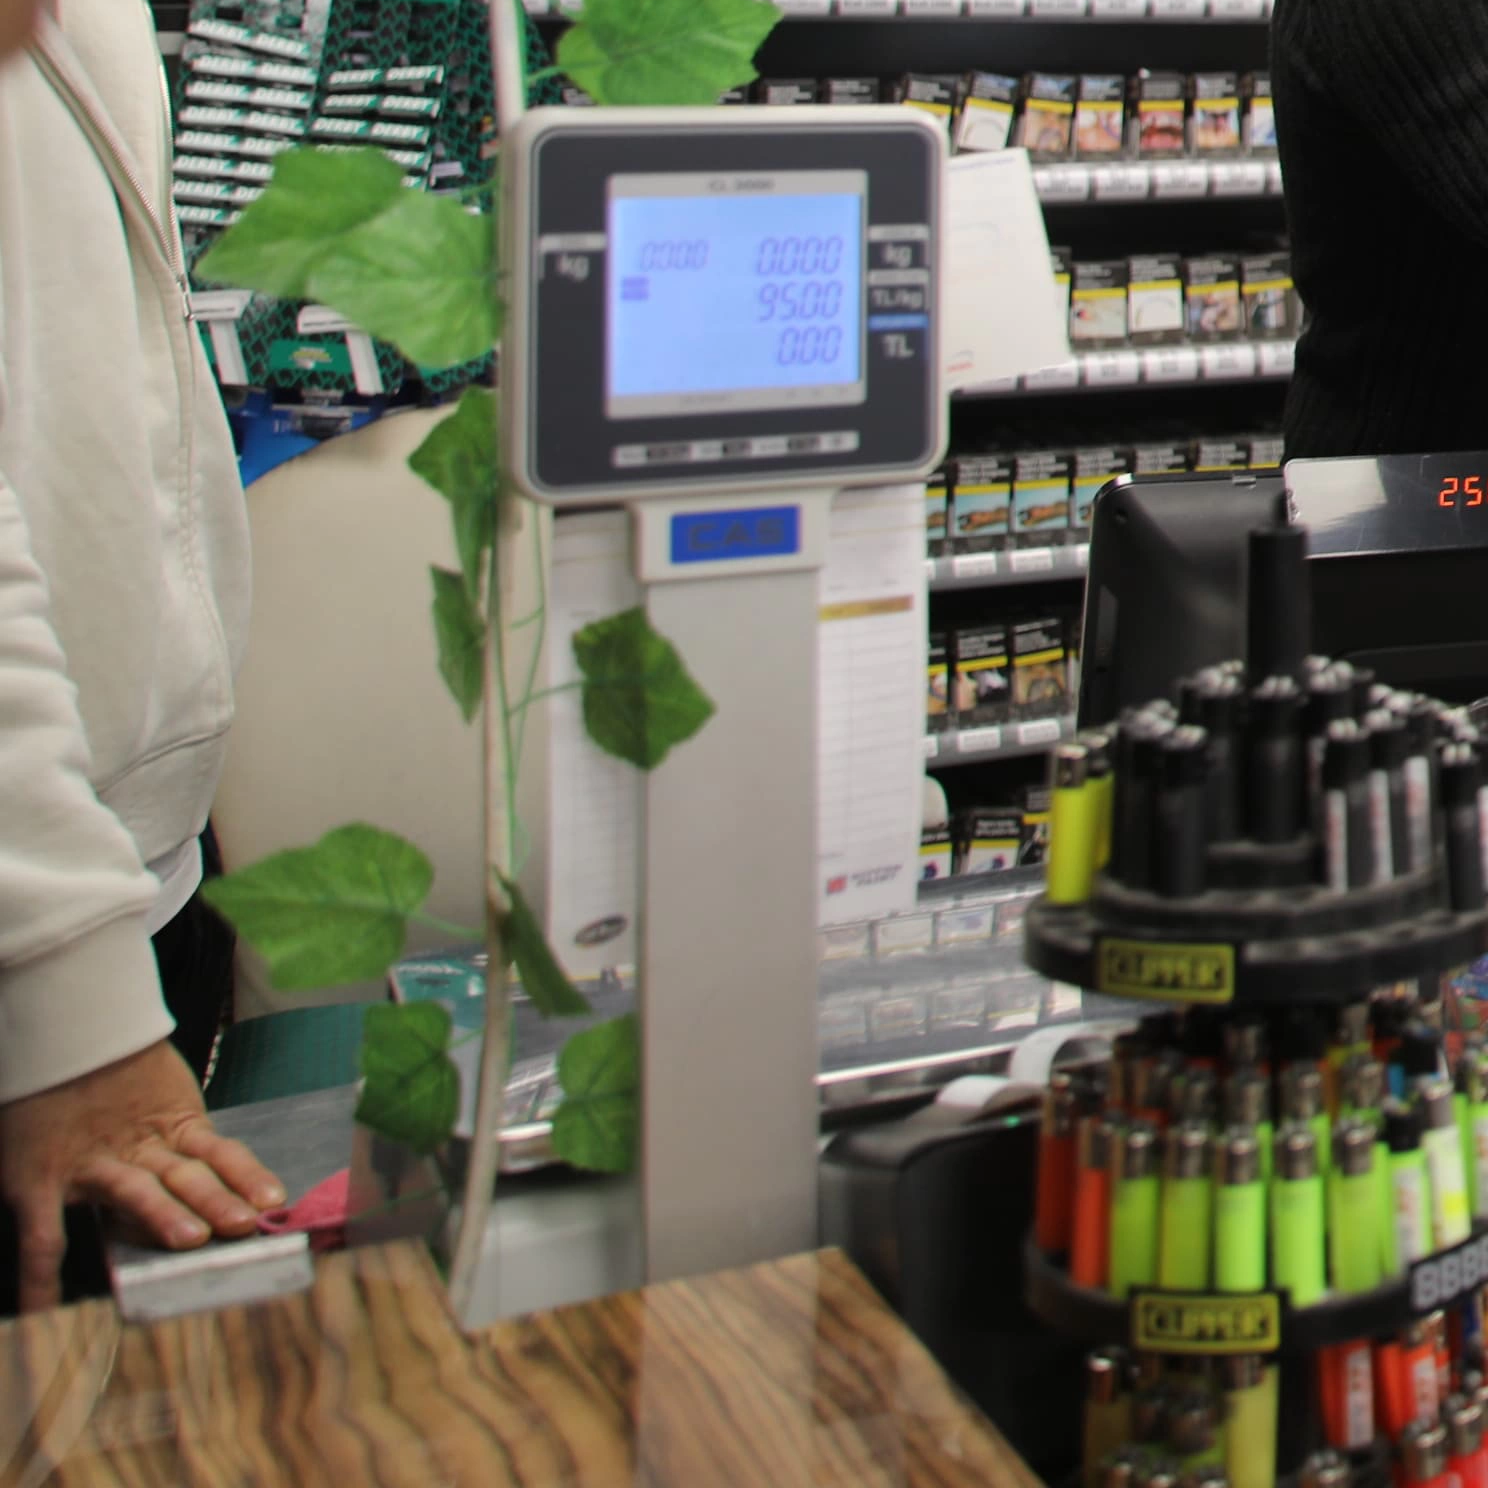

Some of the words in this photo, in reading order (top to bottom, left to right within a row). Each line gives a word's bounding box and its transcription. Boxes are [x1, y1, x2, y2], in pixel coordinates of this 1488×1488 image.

[331, 68, 380, 85] DERBY
[386, 65, 436, 81] DERBY
[326, 94, 377, 108] DERBY
[382, 95, 433, 112] DERBY
[314, 117, 365, 133] DERBY
[371, 122, 426, 140] DERBY
[237, 161, 274, 181] DER
[882, 244, 912, 269] kg
[556, 254, 590, 281] kg
[883, 335, 915, 358] TL
[688, 518, 786, 552] CAS
